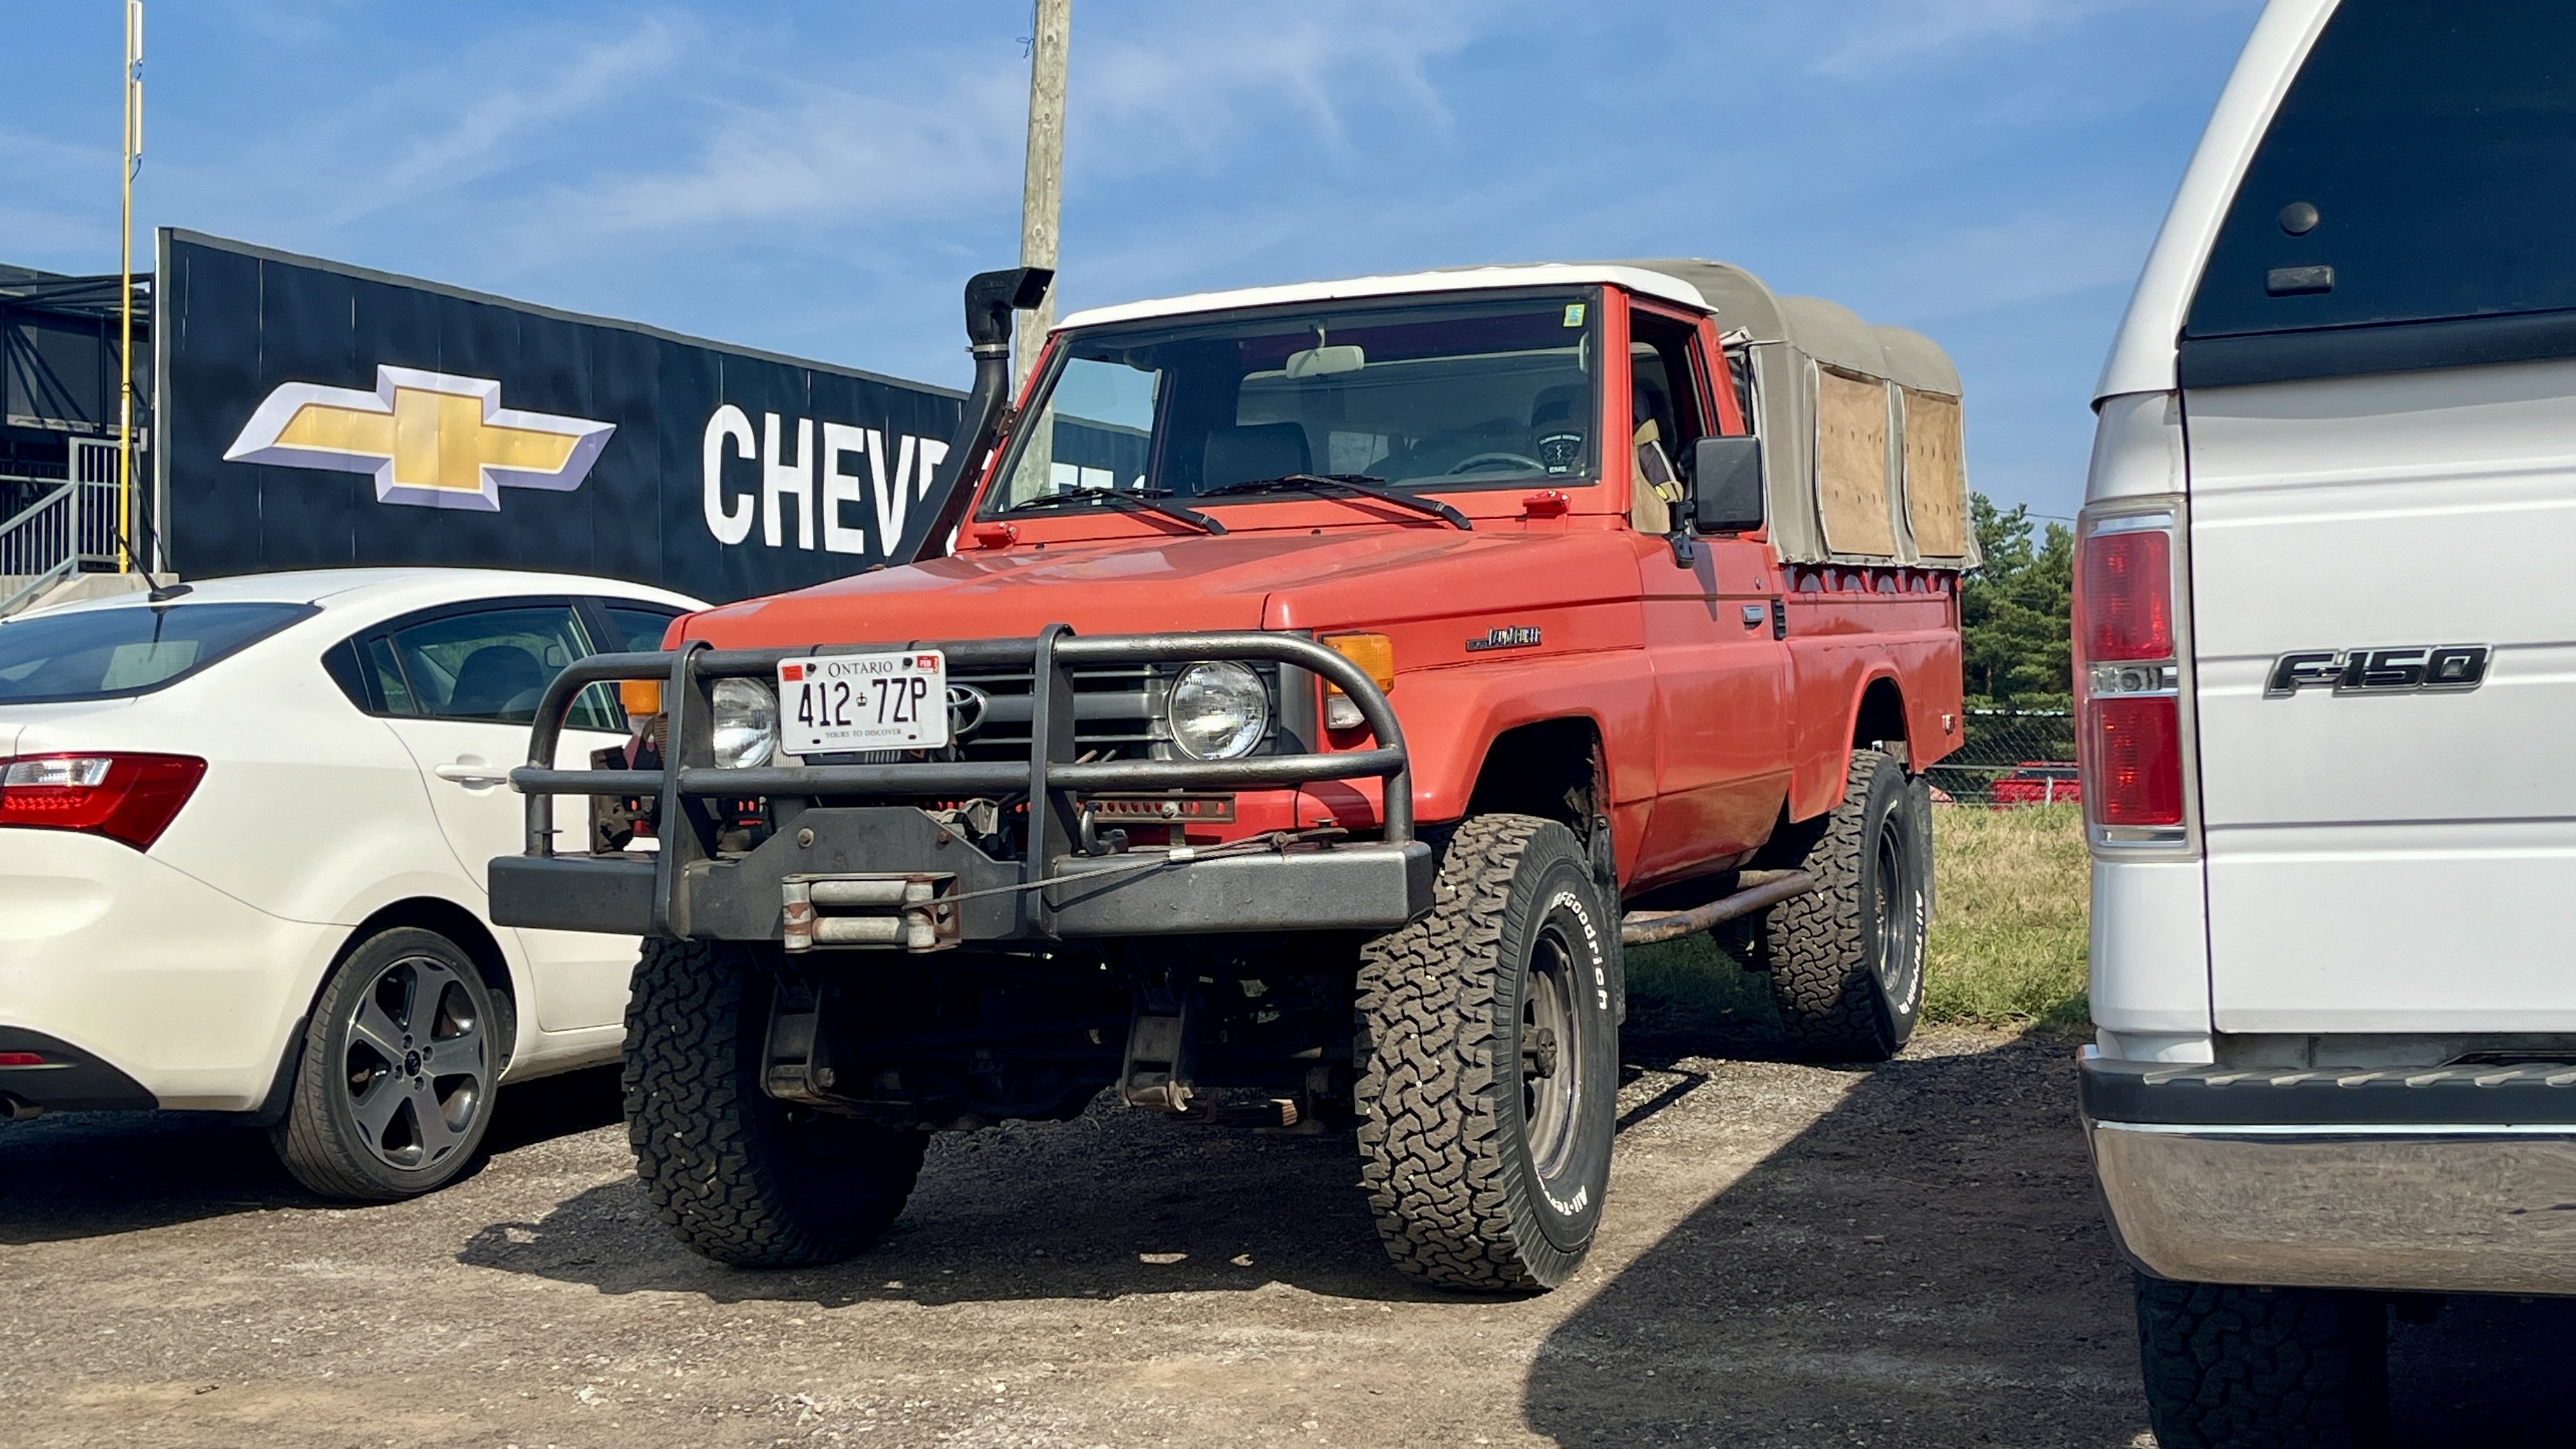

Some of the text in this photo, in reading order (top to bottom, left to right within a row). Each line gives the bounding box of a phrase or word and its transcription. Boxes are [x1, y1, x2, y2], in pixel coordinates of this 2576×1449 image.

[828, 661, 893, 677] ONTARIO
[2263, 643, 2494, 699] F-150
[798, 677, 927, 728] 412 7ZP
